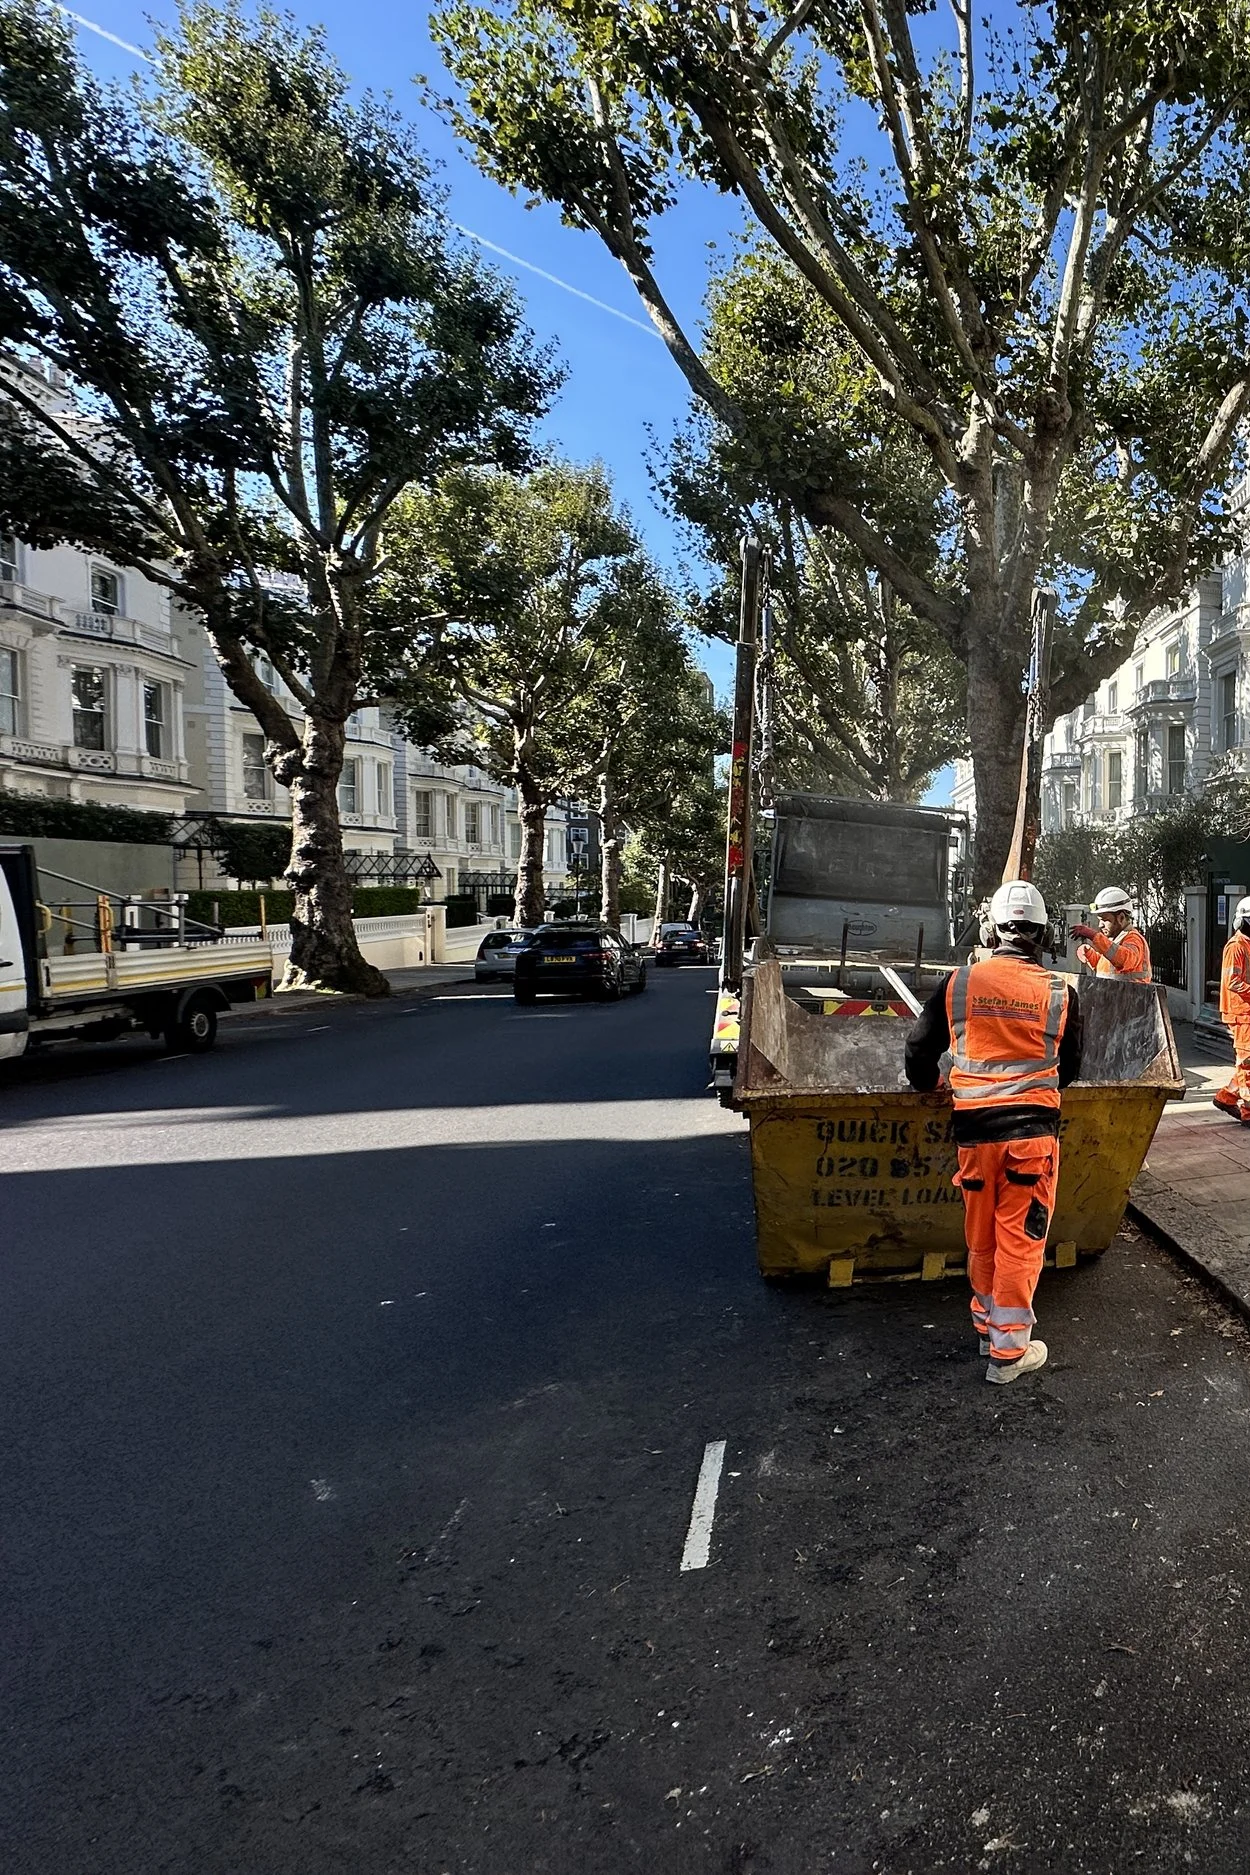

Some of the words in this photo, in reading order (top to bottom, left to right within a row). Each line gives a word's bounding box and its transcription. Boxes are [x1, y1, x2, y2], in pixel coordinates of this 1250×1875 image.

[978, 996, 1007, 1005] Stefan
[1009, 999, 1039, 1010] James
[816, 1119, 910, 1145] QUICK
[811, 1187, 891, 1207] LEVEL
